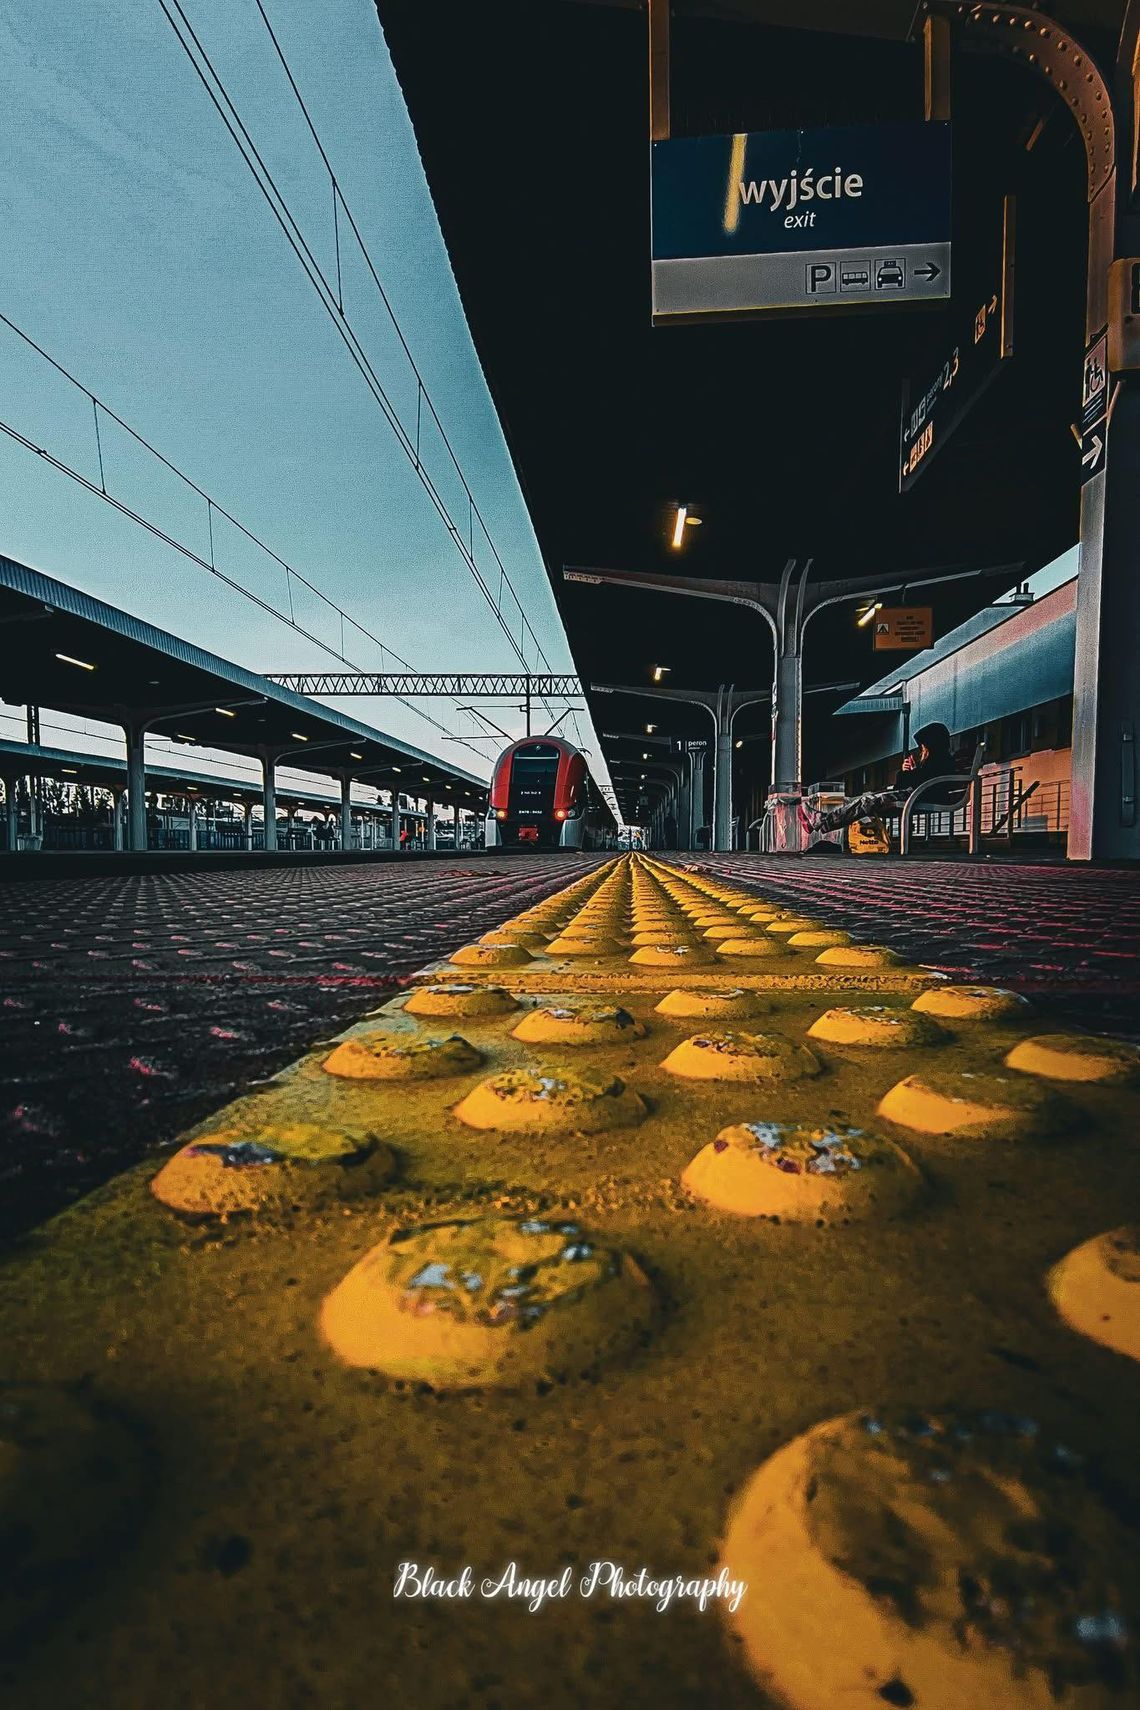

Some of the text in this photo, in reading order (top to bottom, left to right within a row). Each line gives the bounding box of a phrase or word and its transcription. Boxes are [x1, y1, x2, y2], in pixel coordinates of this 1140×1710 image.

[739, 166, 864, 212] wyjście
[784, 210, 817, 229] exit
[811, 265, 832, 292] P
[676, 740, 682, 751] 1
